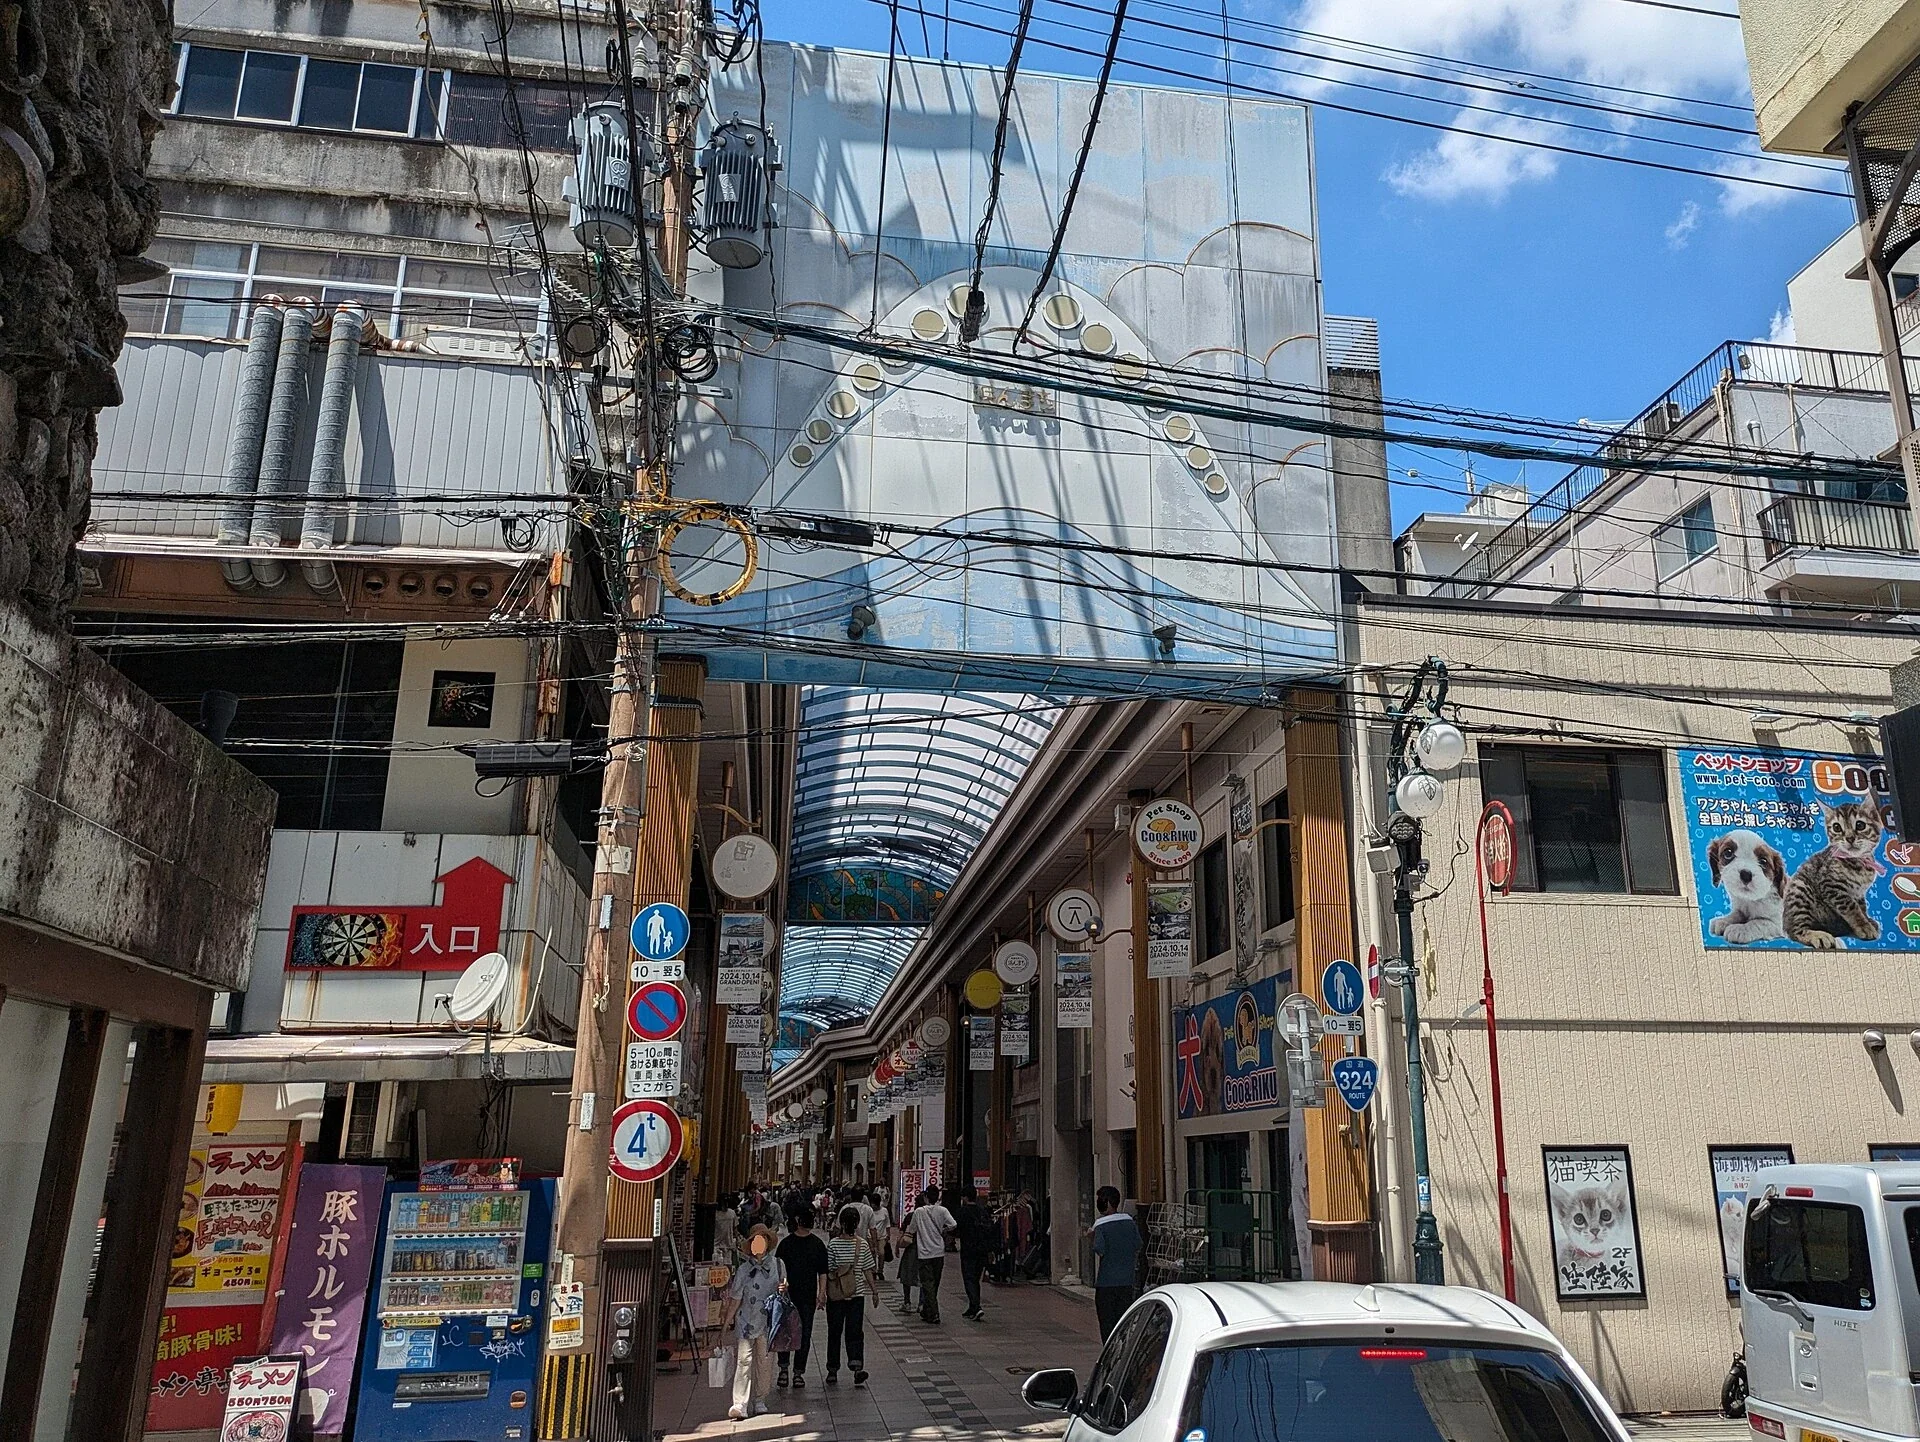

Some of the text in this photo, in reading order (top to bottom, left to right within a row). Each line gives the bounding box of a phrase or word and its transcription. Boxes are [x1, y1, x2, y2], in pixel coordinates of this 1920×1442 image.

[1695, 754, 1803, 774] ペットショップ
[1695, 773, 1806, 789] www.pet-coo.com
[1146, 804, 1192, 822] Pet Shop
[1696, 798, 1820, 815] ワンちゃん・ネコちゃんを
[1148, 851, 1192, 865] Since 1999
[410, 924, 480, 955] 入口
[1150, 945, 1189, 953] 2024.10.14
[630, 1047, 679, 1059] 5-10の間に
[630, 1058, 679, 1070] おける集配中の
[1178, 1013, 1204, 1114] 犬
[634, 1069, 677, 1080] 車両を除く
[1339, 1070, 1374, 1090] 324
[632, 1082, 674, 1093] ここから
[208, 1150, 286, 1175] ラーメン
[1549, 1156, 1623, 1184] 猫喫茶
[905, 1173, 915, 1213] カラオケ
[1612, 1247, 1632, 1259] 2F
[201, 1266, 244, 1277] ギョーザ
[1561, 1260, 1635, 1292] 空陸家
[223, 1278, 251, 1287] 450円
[302, 1190, 358, 1379] 豚ホルモン
[560, 1284, 580, 1294] 注意
[233, 1368, 296, 1390] ラーメン
[228, 1396, 292, 1407] 550円 750円
